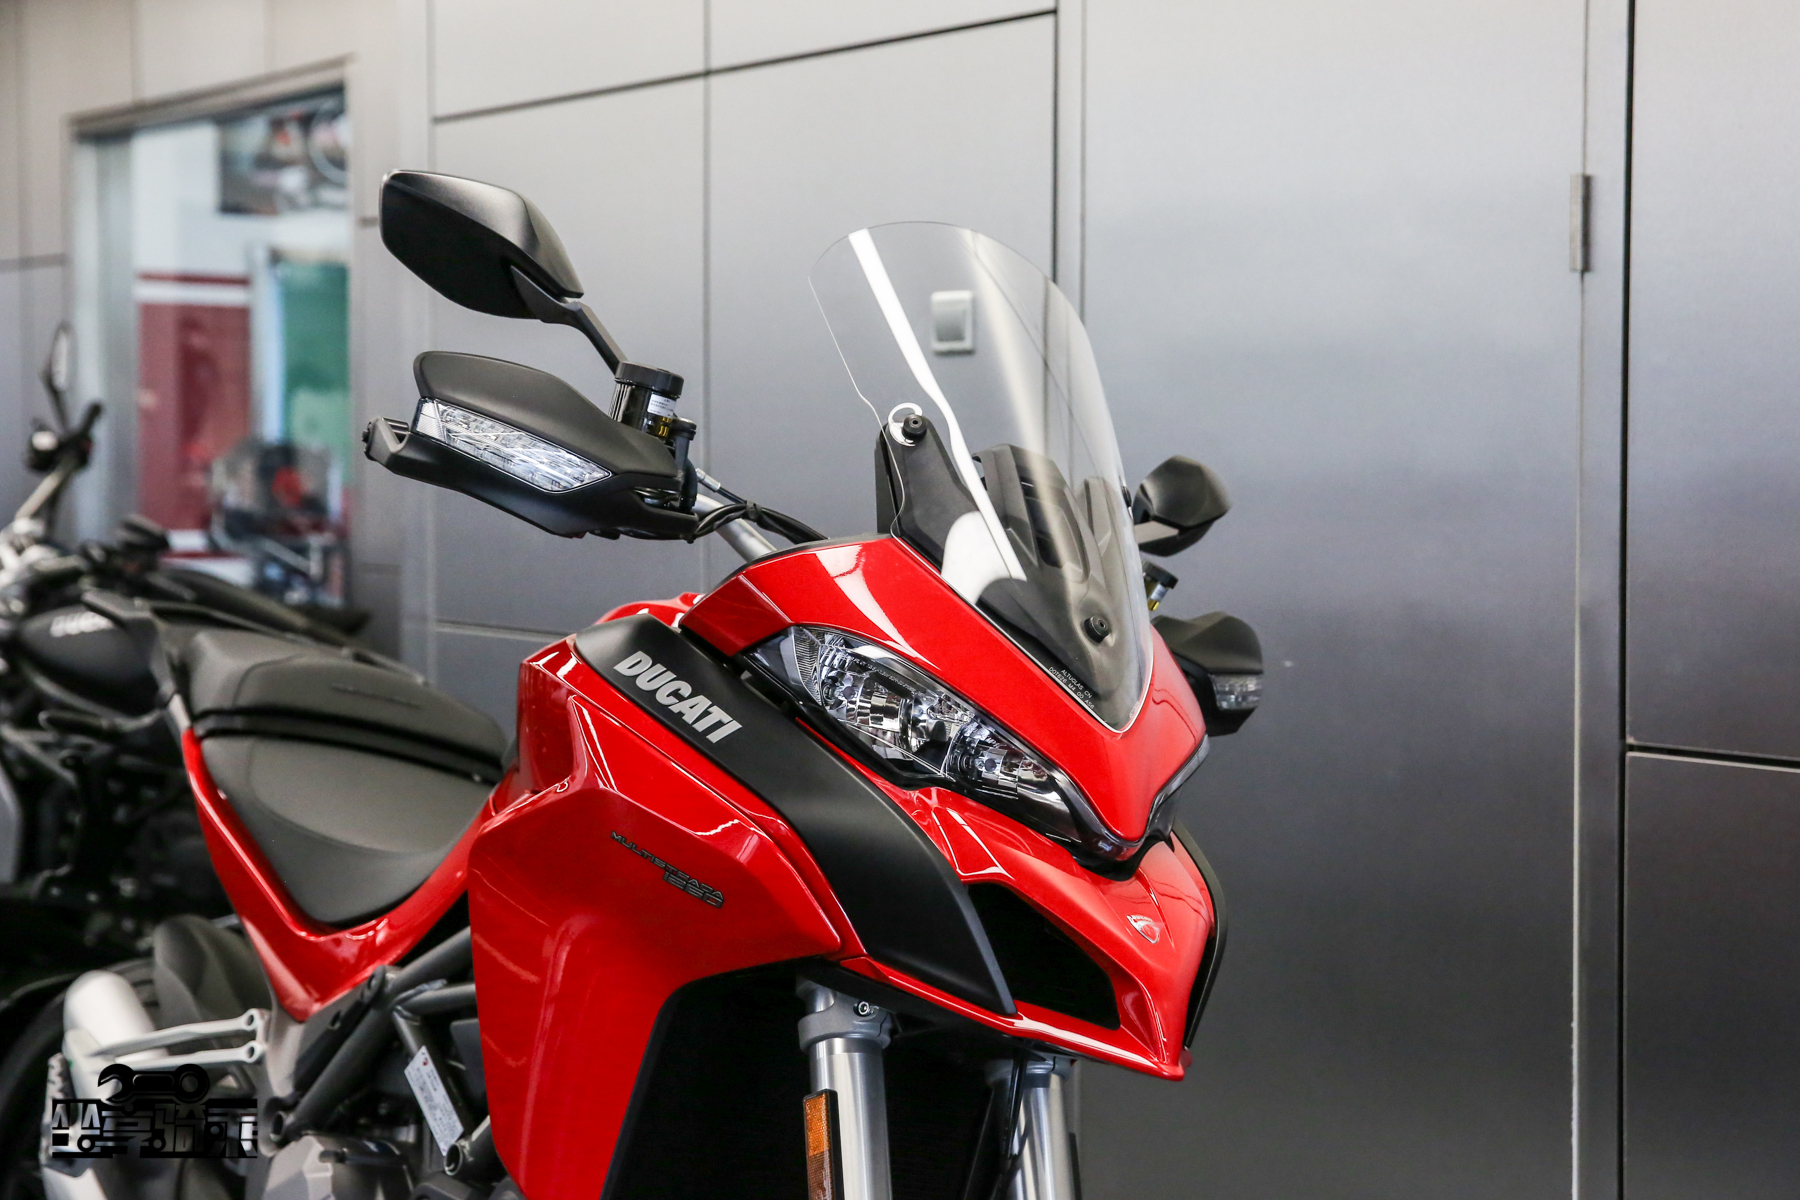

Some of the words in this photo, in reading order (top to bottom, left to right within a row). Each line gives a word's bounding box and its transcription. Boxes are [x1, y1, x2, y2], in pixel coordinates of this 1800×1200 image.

[613, 650, 742, 744] DUCATI
[1061, 669, 1084, 690] ALTUGLAS
[1084, 690, 1093, 699] CN
[610, 830, 724, 901] MULTISTRADA
[662, 871, 725, 909] 1260
